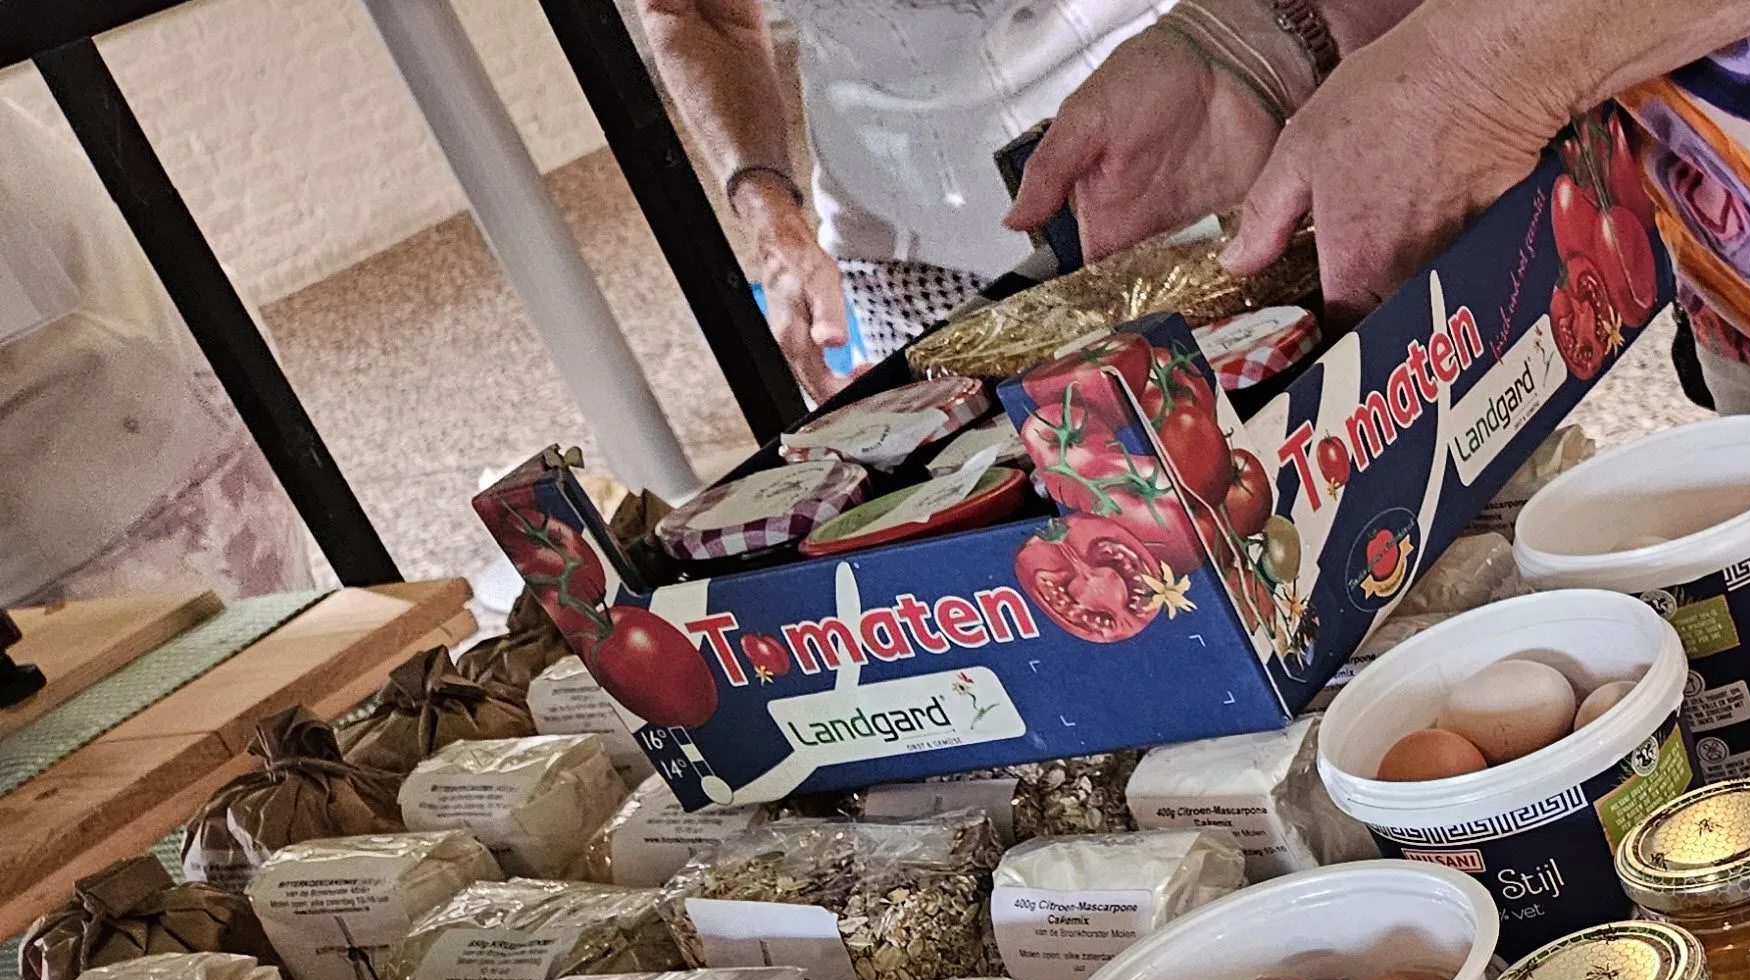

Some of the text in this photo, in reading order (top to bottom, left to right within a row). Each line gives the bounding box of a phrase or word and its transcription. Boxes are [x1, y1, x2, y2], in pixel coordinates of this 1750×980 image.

[1454, 360, 1536, 462] Landgard
[787, 695, 952, 748] Landgard
[1157, 805, 1268, 821] 400g Citroen-Mascarpone
[1498, 858, 1565, 899] Stijl
[1014, 899, 1138, 914] 400g Citroen-Mascarpone
[1512, 903, 1545, 921] vet
[1048, 914, 1090, 926] Cakemix
